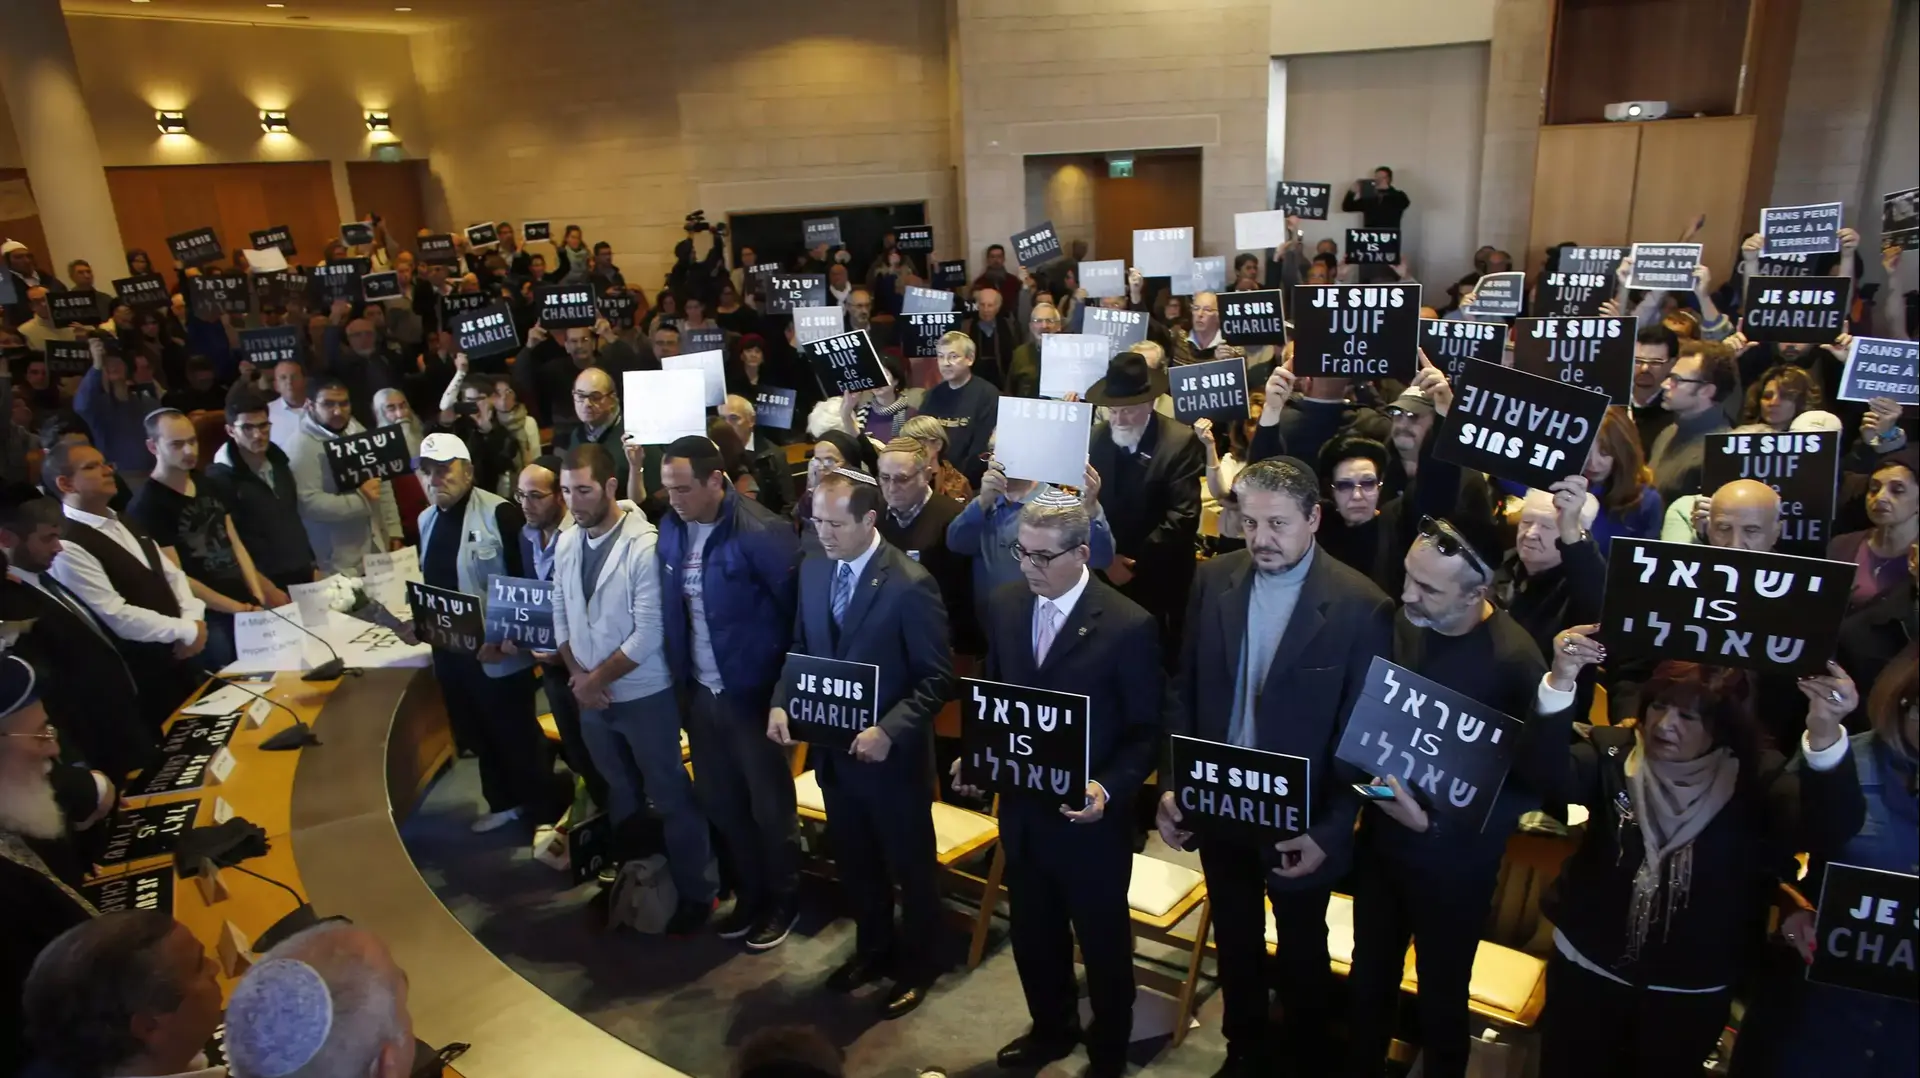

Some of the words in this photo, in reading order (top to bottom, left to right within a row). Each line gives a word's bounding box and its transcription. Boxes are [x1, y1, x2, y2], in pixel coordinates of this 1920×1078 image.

[1281, 185, 1327, 198] ישראל
[1296, 196, 1308, 205] IS
[1767, 211, 1800, 221] SANS
[1803, 208, 1838, 219] PEUR
[1142, 230, 1155, 242] JE
[1157, 228, 1186, 241] SUIS
[1351, 230, 1398, 243] ישראל
[1768, 225, 1801, 235] FACE
[1804, 221, 1815, 232] À
[1817, 222, 1834, 232] LA
[1018, 236, 1030, 248] JE
[1031, 229, 1052, 244] SUIS
[1366, 242, 1379, 251] IS
[1770, 236, 1830, 247] TERREUR
[1019, 238, 1060, 262] CHARLIE
[1569, 249, 1586, 260] JE
[1589, 248, 1621, 260] SUIS
[1637, 247, 1666, 256] SANS
[1667, 247, 1699, 257] PEUR
[314, 266, 327, 276] JE
[329, 264, 355, 275] SUIS
[749, 264, 759, 273] JE
[760, 262, 779, 271] SUIS
[1578, 260, 1610, 273] JUIF
[1637, 260, 1665, 269] FACE
[1667, 258, 1677, 268] À
[1678, 261, 1693, 269] LA
[194, 277, 243, 291] ישראל
[772, 277, 819, 290] ישראל
[1547, 273, 1566, 286] JE
[1569, 273, 1605, 287] SUIS
[1638, 272, 1689, 282] TERREUR
[214, 290, 227, 299] IS
[544, 294, 559, 305] JE
[561, 291, 588, 304] SUIS
[789, 291, 802, 299] IS
[911, 287, 924, 296] JE
[925, 288, 949, 300] SUIS
[1312, 288, 1340, 307] JE
[1348, 287, 1404, 307] SUIS
[1555, 287, 1593, 301] JUIF
[1758, 290, 1783, 304] JE
[1788, 289, 1836, 305] SUIS
[542, 305, 594, 321] CHARLIE
[1093, 308, 1108, 322] JE
[1111, 310, 1140, 324] SUIS
[1226, 302, 1242, 316] JE
[1244, 301, 1274, 316] SUIS
[1563, 301, 1580, 315] de
[461, 319, 476, 333] JE
[477, 313, 504, 329] SUIS
[800, 316, 812, 326] JE
[814, 315, 837, 326] SUIS
[909, 315, 923, 325] JE
[925, 314, 955, 324] SUIS
[1223, 317, 1281, 335] CHARLIE
[1328, 310, 1385, 335] JUIF
[1748, 309, 1840, 328] CHARLIE
[460, 323, 514, 349] CHARLIE
[1428, 321, 1448, 336] JE
[1454, 323, 1495, 340] SUIS
[1531, 320, 1560, 338] JE
[1566, 318, 1622, 338] SUIS
[814, 341, 831, 355] JE
[832, 334, 861, 350] SUIS
[1344, 338, 1367, 355] de
[1438, 338, 1481, 357] JUIF
[1546, 340, 1602, 363] JUIF
[1858, 343, 1901, 358] SANS
[828, 349, 858, 369] JUIF
[1321, 353, 1389, 375] France
[1447, 359, 1466, 373] de
[844, 366, 859, 379] de
[1560, 363, 1585, 383] de
[1856, 362, 1900, 376] FACE
[1902, 361, 1915, 377] À
[837, 377, 874, 393] France
[1180, 375, 1199, 392] JE
[1201, 371, 1236, 388] SUIS
[1856, 379, 1919, 395] TERREU
[756, 393, 767, 402] JE
[769, 394, 790, 405] SUIS
[1177, 389, 1244, 413] CHARLIE
[1013, 402, 1031, 418] JE
[1037, 404, 1078, 422] SUIS
[1458, 384, 1589, 444] CHARLIE
[330, 430, 396, 458] ישראל
[1458, 422, 1524, 459] SUIS
[1722, 436, 1751, 455] JE
[1760, 434, 1821, 453] SUIS
[360, 453, 376, 466] IS
[1528, 443, 1566, 471] JE
[340, 460, 404, 483] שארלי
[1740, 455, 1799, 478] JUIF
[1633, 546, 1823, 599] ישראל
[414, 586, 472, 615] ישראל
[1693, 597, 1738, 621] IS
[437, 615, 452, 628] IS
[514, 607, 529, 621] IS
[493, 620, 551, 645] שארלי
[1622, 611, 1805, 663] שארלי
[797, 673, 816, 693] JE
[822, 677, 863, 700] SUIS
[789, 697, 869, 731] CHARLIE
[973, 686, 1072, 732] ישראל
[1383, 668, 1503, 744] ישראל
[1009, 732, 1033, 756] IS
[1409, 727, 1443, 756] IS
[190, 754, 211, 764] JE
[175, 765, 203, 785] SUIS
[973, 747, 1070, 795] שארלי
[1359, 730, 1478, 808] שארלי
[1190, 760, 1219, 783] JE
[1228, 767, 1289, 796] SUIS
[1181, 786, 1299, 832] CHARLIE
[137, 824, 157, 839] IS
[137, 877, 159, 891] JE
[1850, 895, 1899, 925] JE
